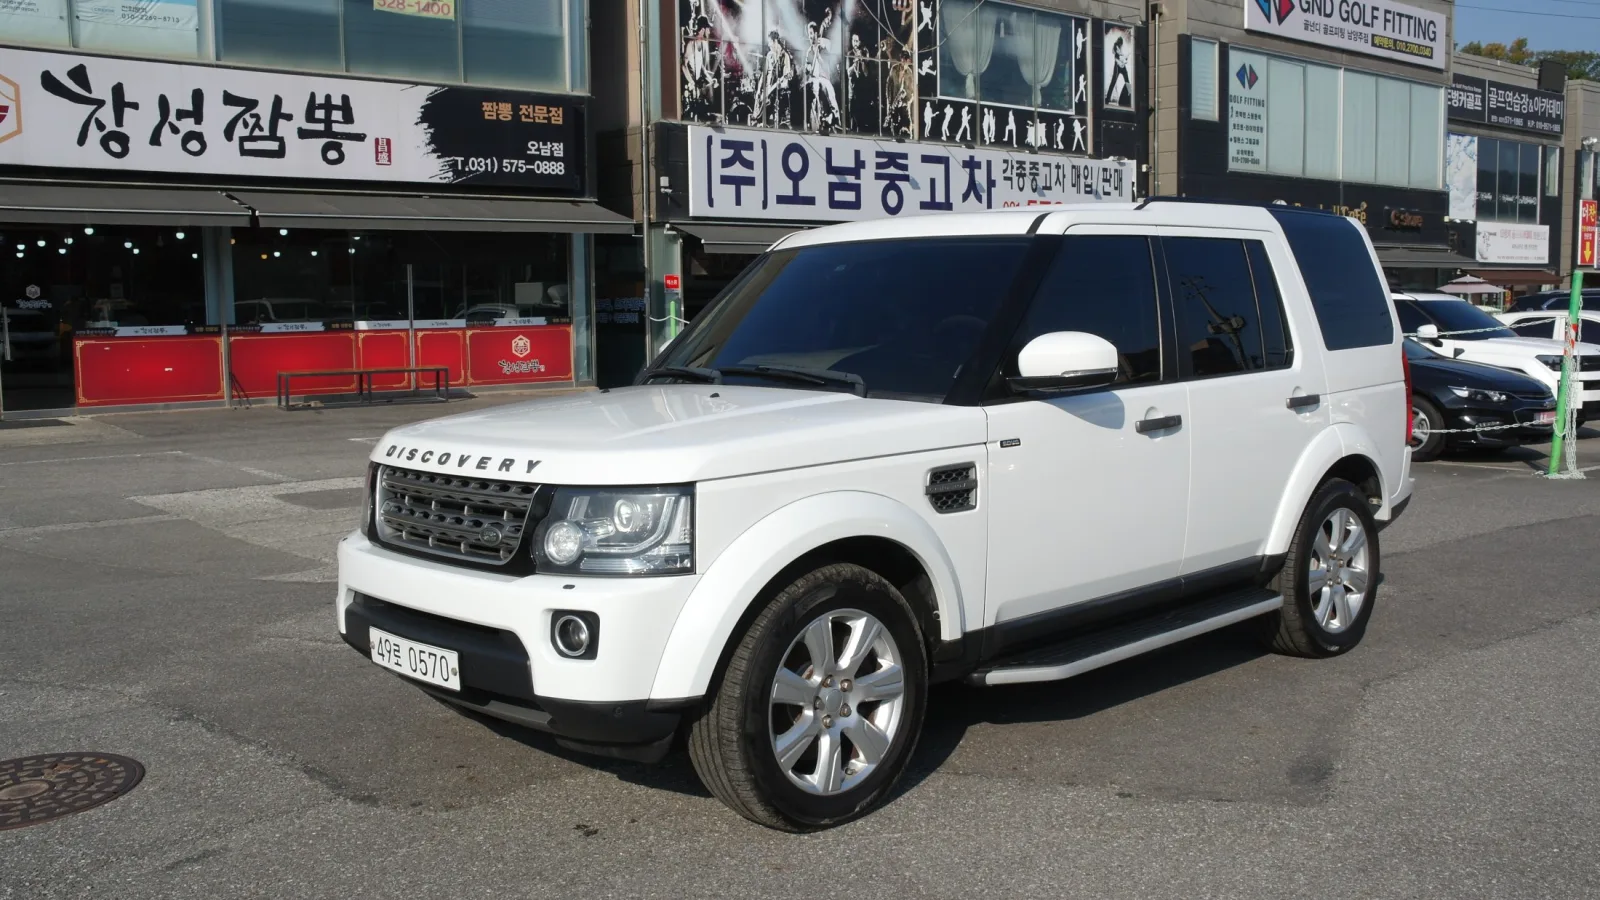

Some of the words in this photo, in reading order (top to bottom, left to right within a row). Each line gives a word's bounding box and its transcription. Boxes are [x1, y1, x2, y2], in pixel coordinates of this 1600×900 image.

[1300, 0, 1335, 19] GND
[1338, 0, 1380, 29] GOLF
[1383, 10, 1437, 43] FITTING
[40, 63, 367, 166] 창성짬뽕
[481, 101, 513, 121] 짬뽕
[519, 104, 564, 125] 전문점
[455, 157, 499, 174] T.031)
[502, 159, 565, 176] 575-0888
[526, 140, 564, 158] 오남점
[706, 134, 997, 216] (주)오남중고차
[1002, 158, 1066, 194] 각종중고차
[1070, 164, 1124, 198] 매입/판매
[385, 445, 542, 474] DISCOVERY
[377, 636, 402, 668] 49로
[408, 646, 449, 682] 0570
